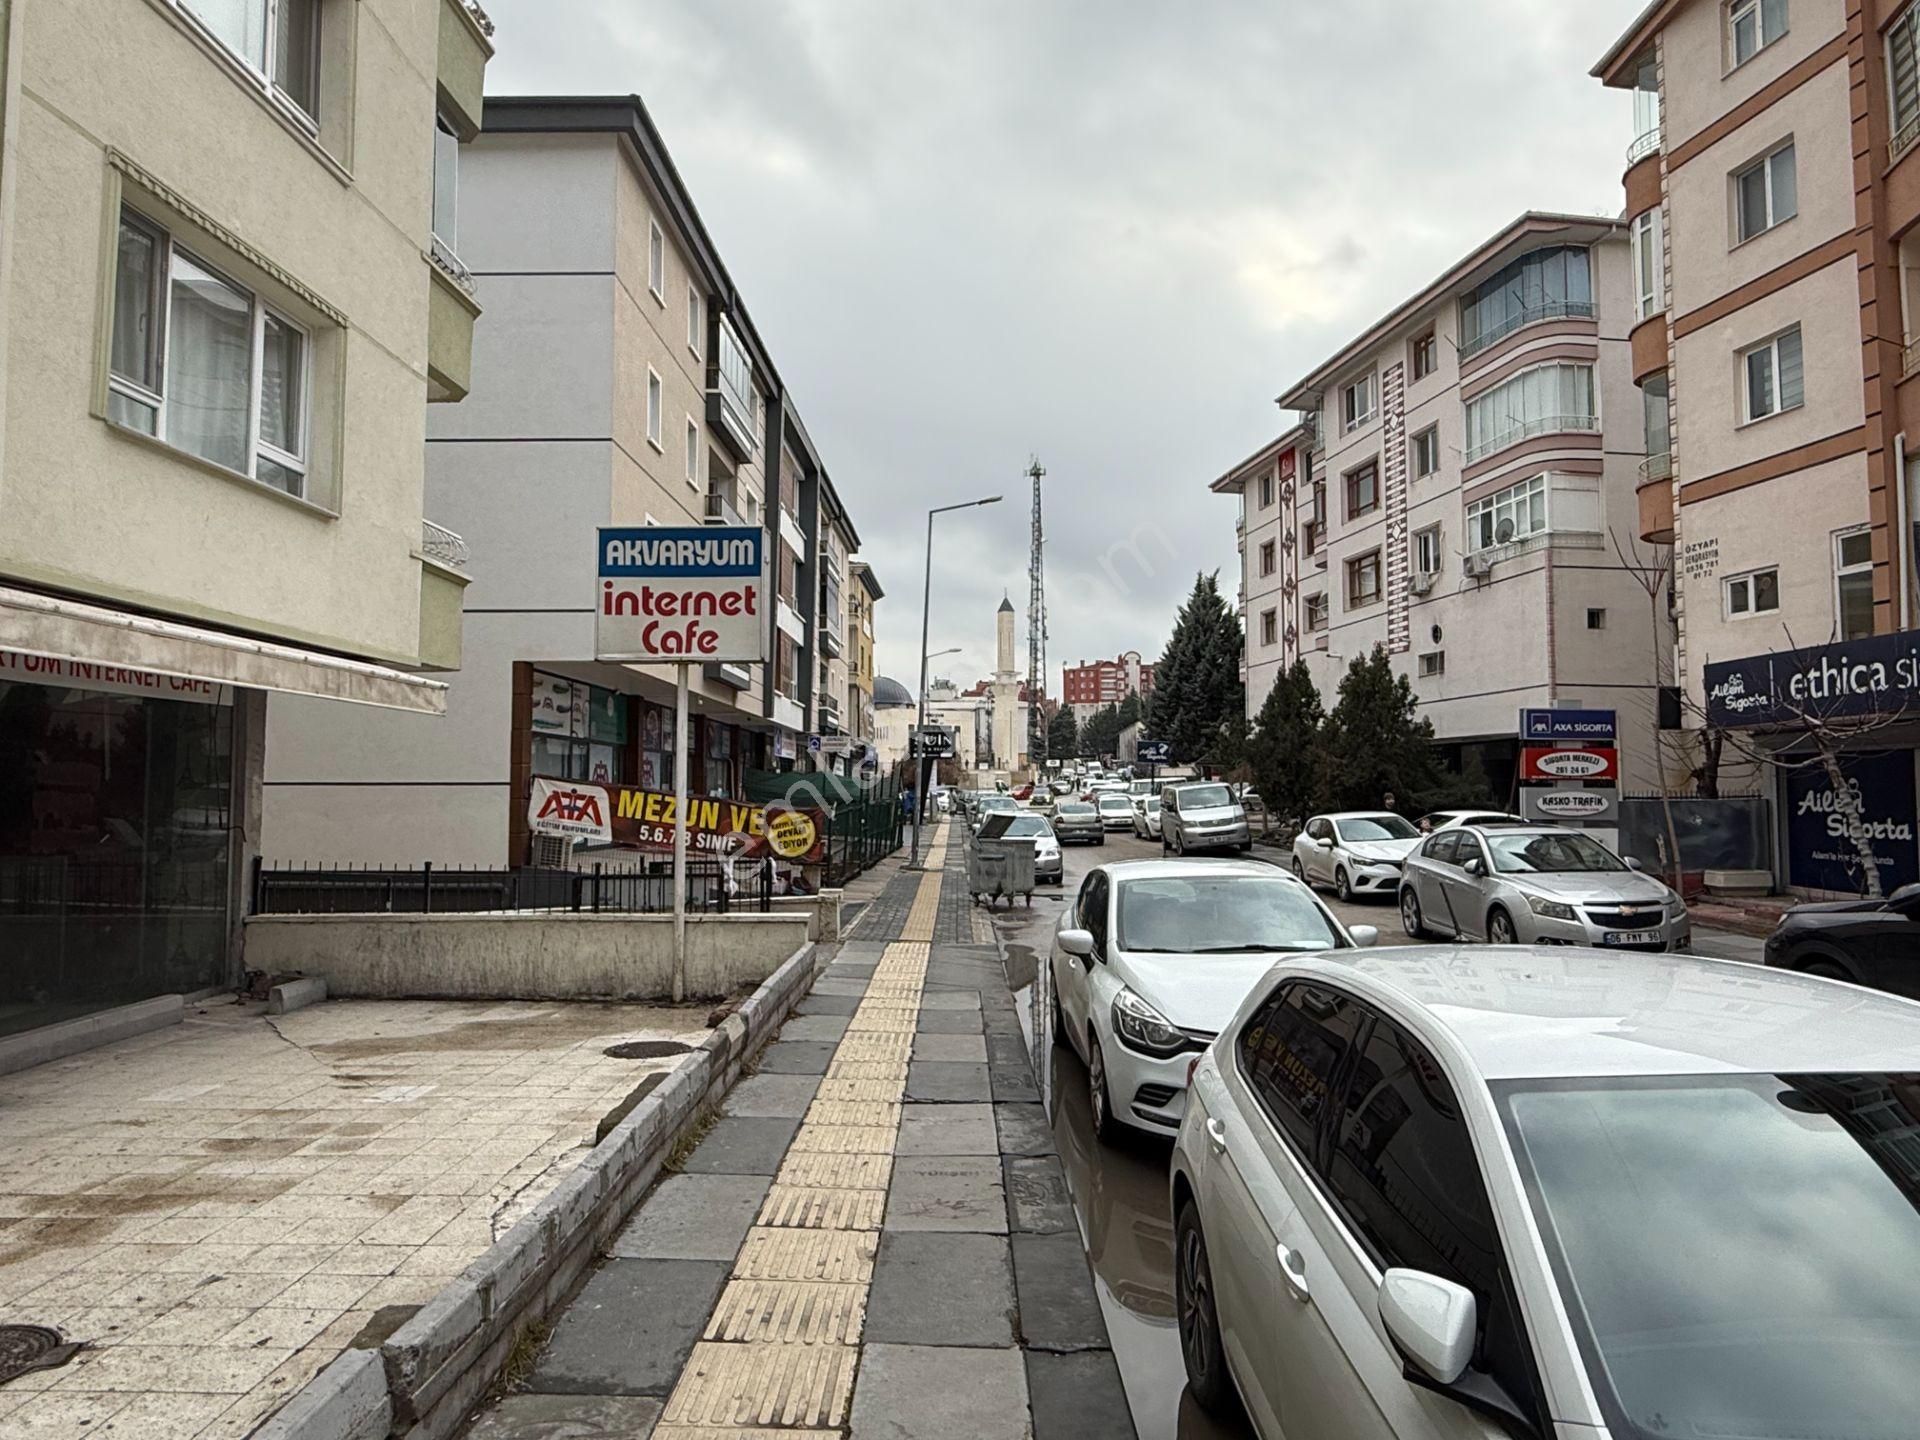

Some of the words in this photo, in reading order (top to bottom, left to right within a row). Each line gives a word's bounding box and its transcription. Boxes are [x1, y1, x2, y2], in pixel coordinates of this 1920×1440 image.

[606, 539, 754, 566] AKVARYUM
[603, 580, 756, 616] internet
[642, 620, 719, 655] Cafe
[1789, 656, 1889, 700] ethica
[1896, 648, 1920, 690] si
[1553, 723, 1572, 732] AXA
[617, 789, 720, 830] MEZUN
[1542, 797, 1571, 806] KASKO
